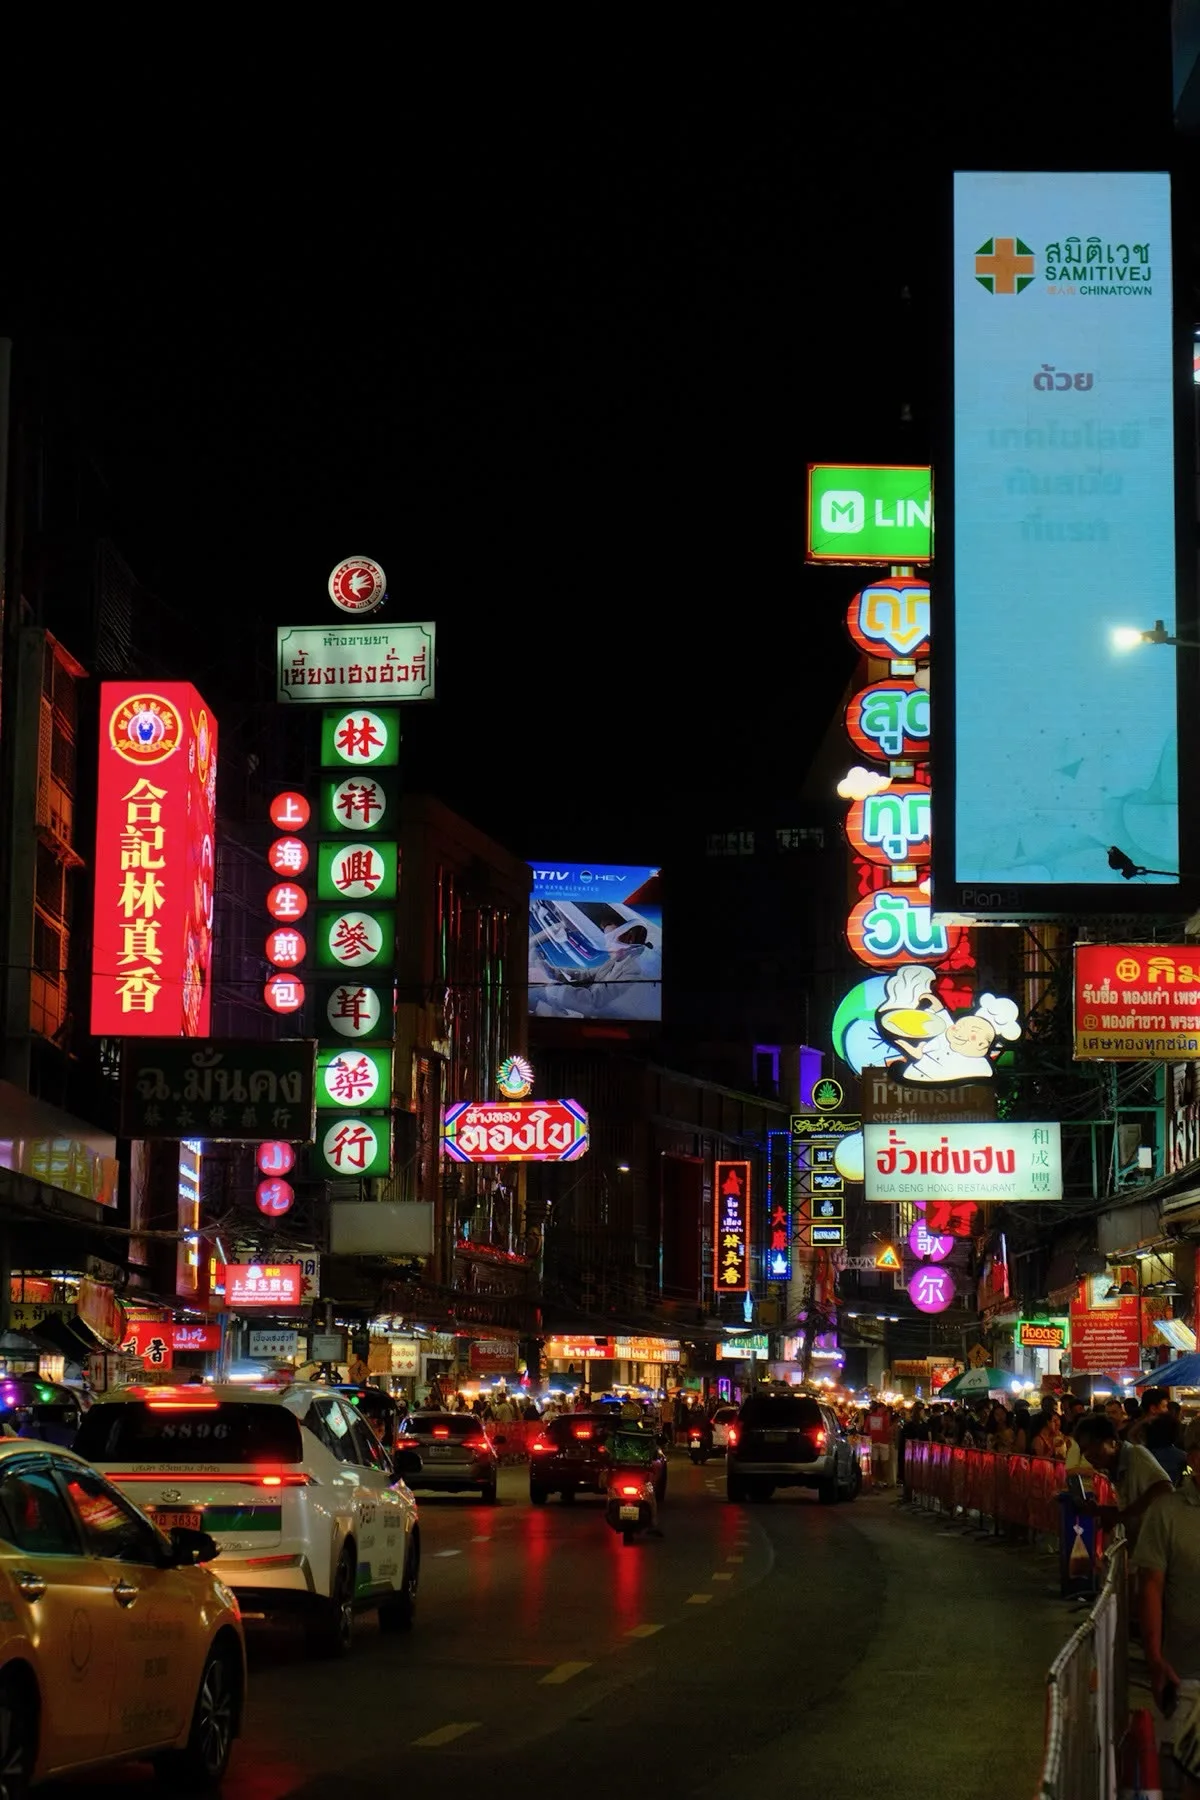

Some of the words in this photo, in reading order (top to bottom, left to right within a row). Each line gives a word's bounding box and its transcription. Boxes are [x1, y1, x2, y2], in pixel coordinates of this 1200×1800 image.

[1045, 236, 1150, 264] สมิติเวช
[1045, 266, 1151, 281] SAMITIVEJ
[1079, 286, 1152, 295] CHINATOWN
[1033, 364, 1093, 391] ด้วย
[323, 633, 389, 646] ห้างขายยา
[115, 777, 169, 1014] 合記林真香
[271, 798, 303, 1008] 上海生煎包
[868, 899, 947, 950] วัน
[1082, 978, 1118, 1005] รับซื้อ
[1122, 986, 1169, 1005] ทองเก่า
[1102, 1009, 1165, 1029] ทองคำขาว
[1083, 1033, 1198, 1055] เศษทองทุกชนิด
[466, 1109, 521, 1124] ห้างทอง
[458, 1110, 572, 1152] ทองใบ
[876, 1129, 1016, 1175] ฮั่วเซ่งฮง
[877, 1183, 896, 1192] HUA
[898, 1183, 924, 1192] SENG
[928, 1183, 954, 1192] HONG
[957, 1183, 1016, 1192] RESTAURANT
